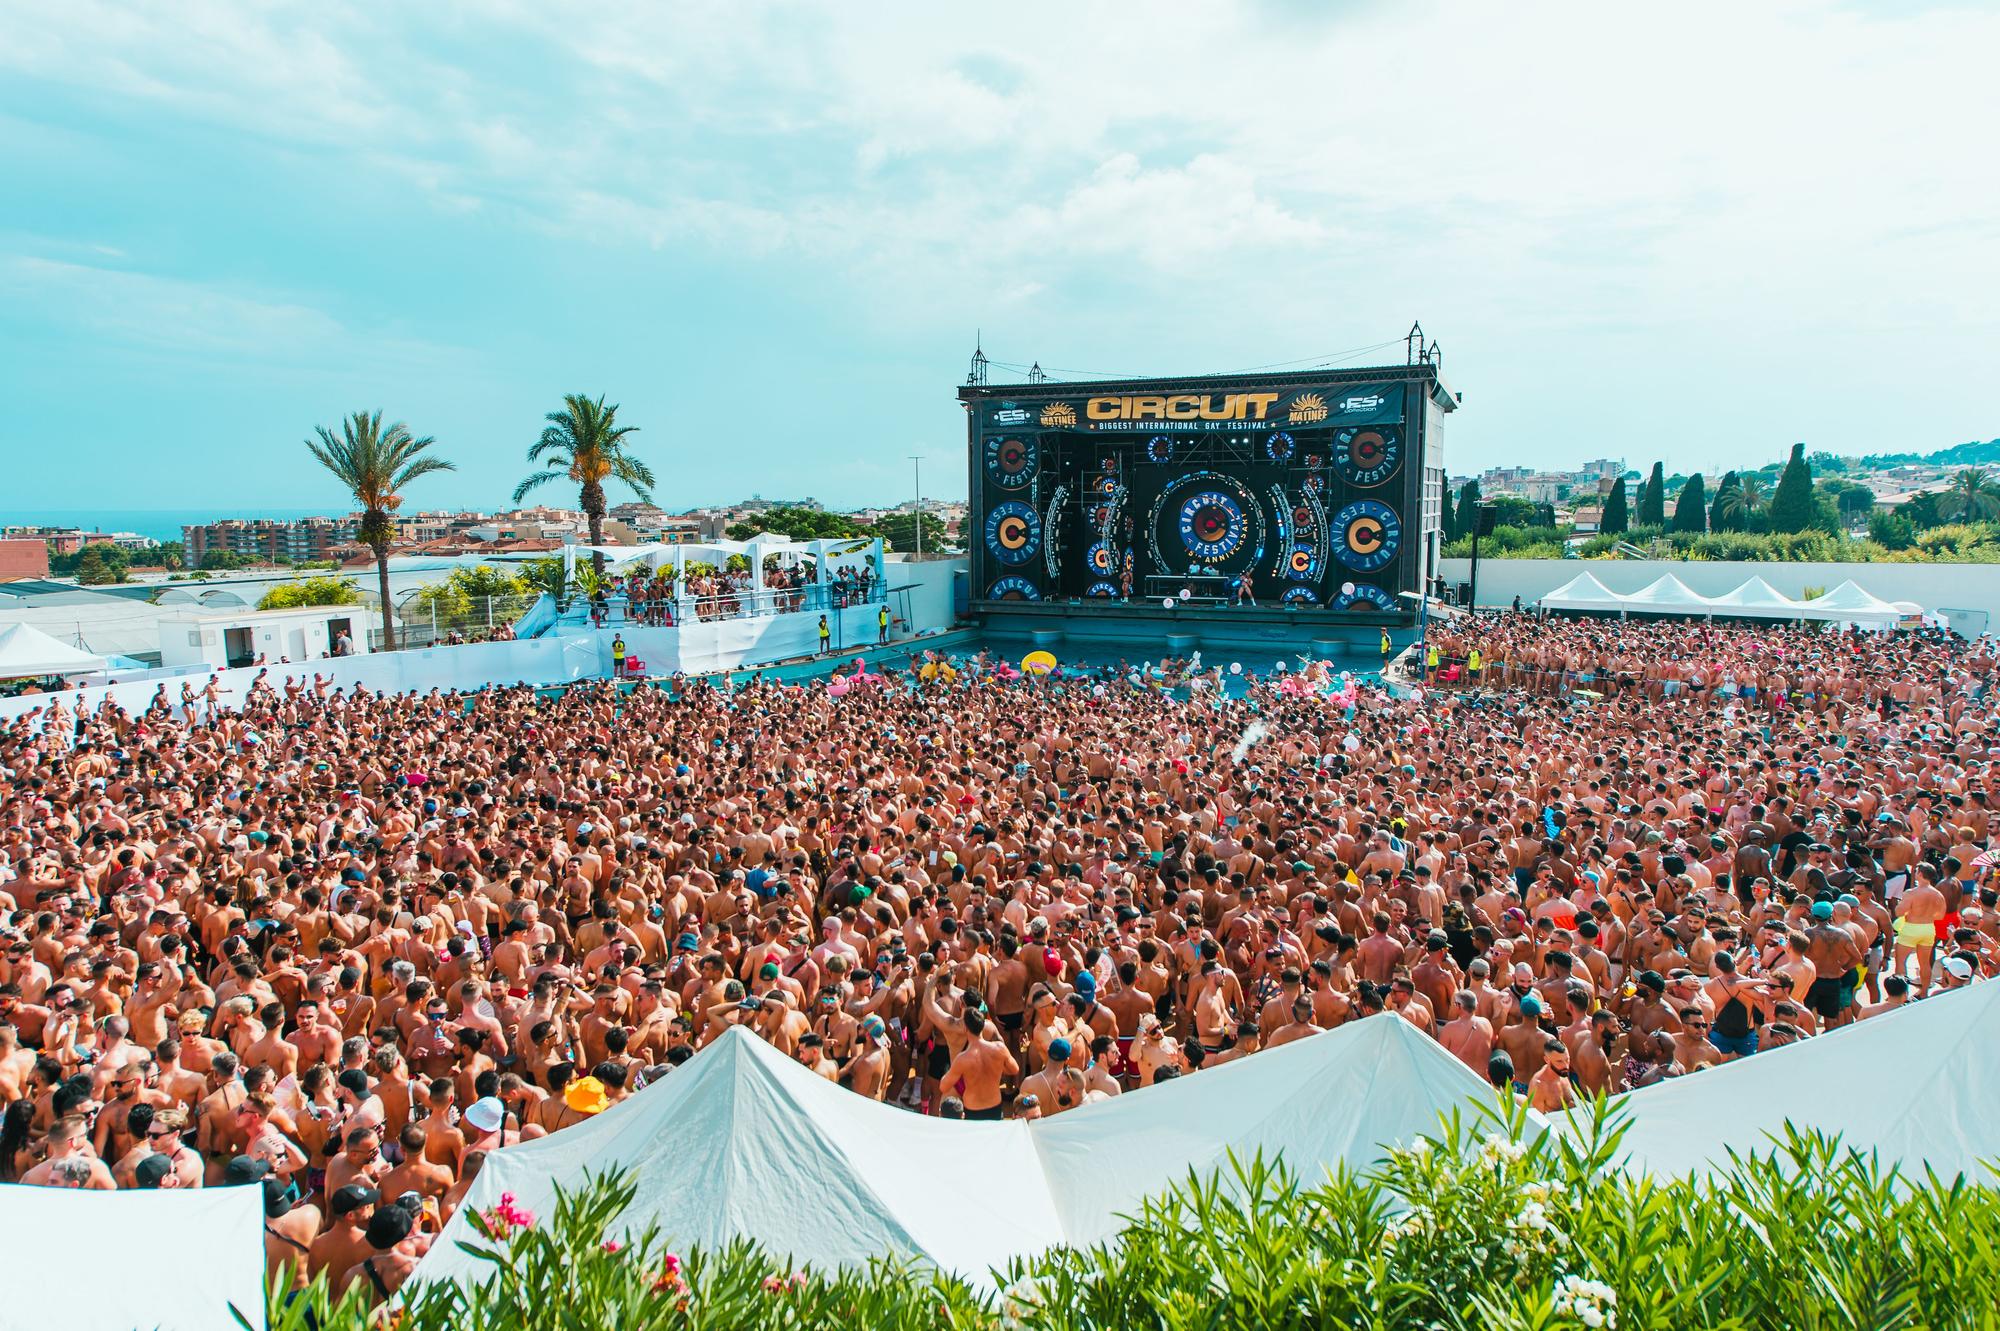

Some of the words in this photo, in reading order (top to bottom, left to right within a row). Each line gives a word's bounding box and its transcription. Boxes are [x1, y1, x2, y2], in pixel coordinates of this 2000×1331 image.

[1040, 415, 1077, 426] MATINEE
[1086, 393, 1279, 420] CIRCUIT
[1099, 422, 1133, 430] BIGGEST
[1136, 422, 1198, 430] INTERNATIONAL
[1205, 422, 1220, 430] GAY
[1227, 421, 1267, 430] FESTIVAL
[1289, 409, 1328, 422] MATINEE
[1003, 445, 1036, 486] FESTIVAL
[1354, 437, 1397, 483] FESTIVAL
[1013, 510, 1041, 562] CIRCUIT
[1194, 515, 1241, 555] FESTIVAL
[1364, 510, 1399, 568] CIRCUIT
